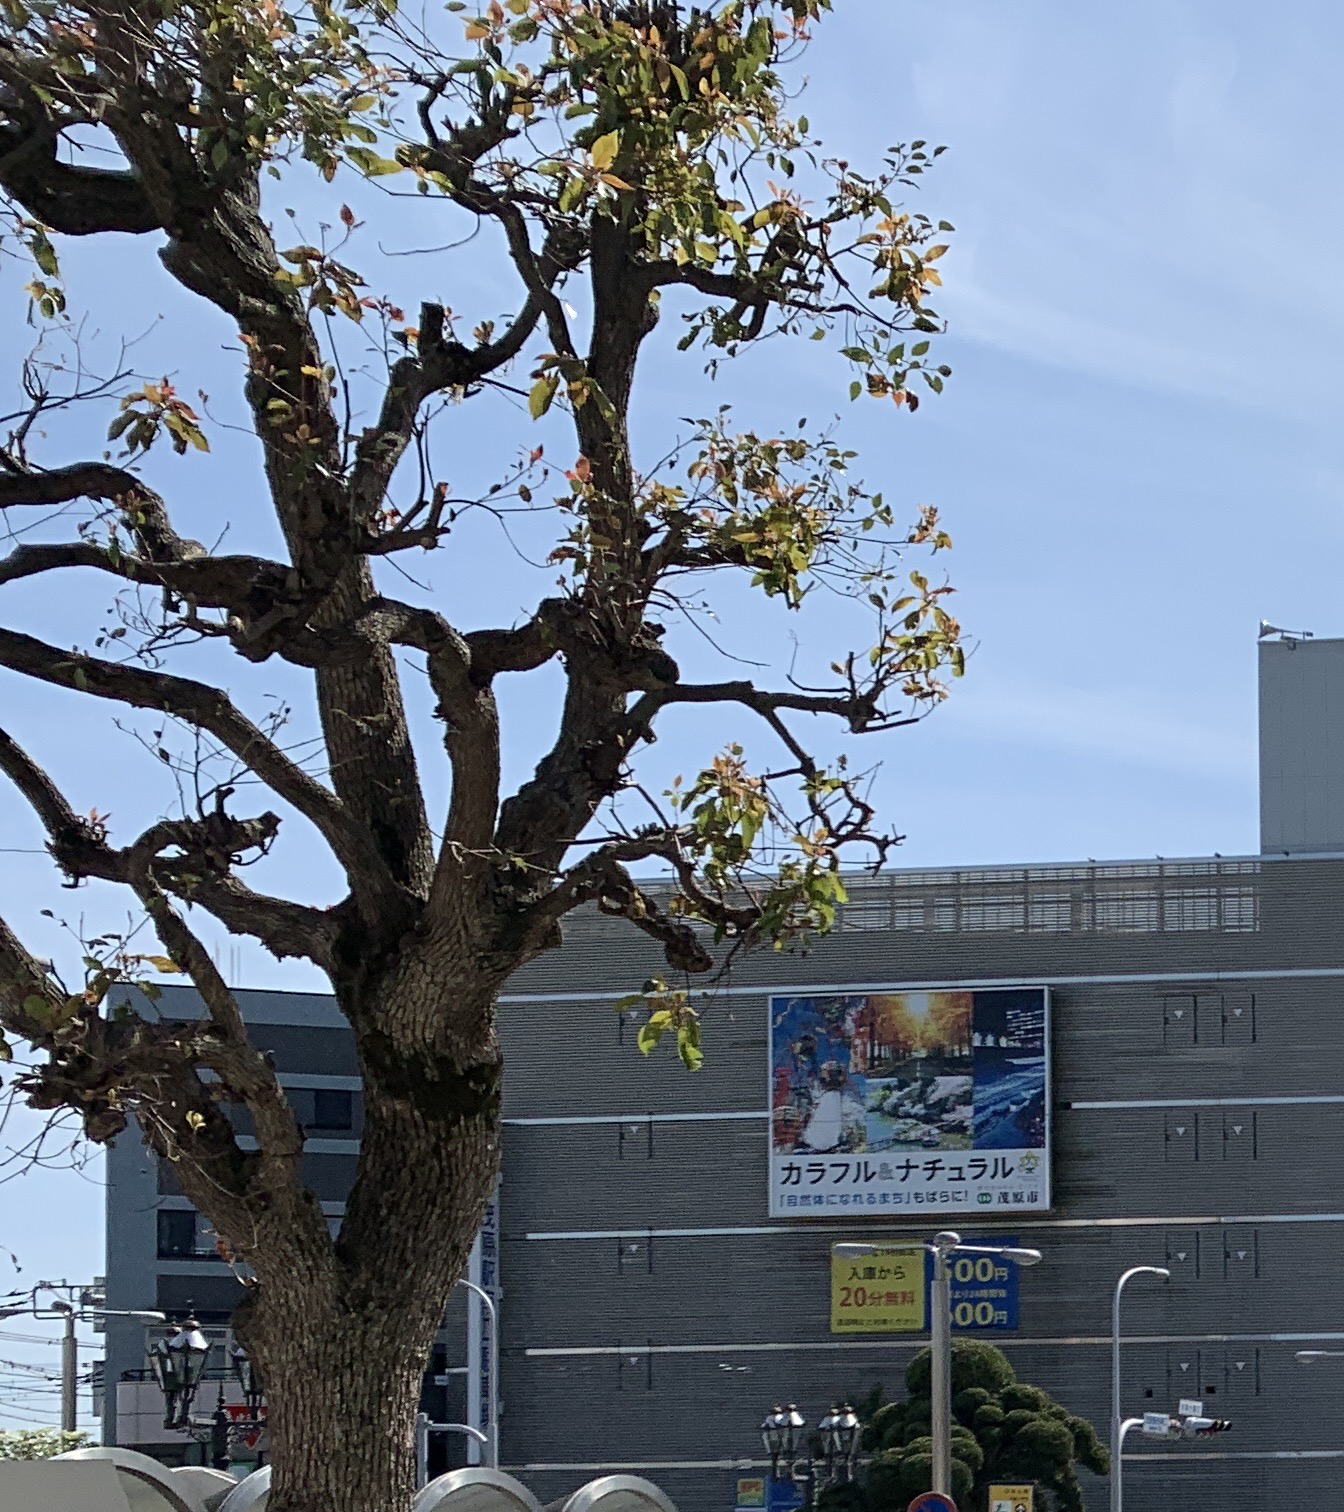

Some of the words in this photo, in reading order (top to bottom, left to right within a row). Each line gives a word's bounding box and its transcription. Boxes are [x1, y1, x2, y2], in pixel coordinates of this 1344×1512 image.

[780, 1156, 1014, 1185] カラフル&ナチュラル
[848, 1265, 906, 1281] 入庫から
[839, 1286, 916, 1307] 20分無料
[950, 1302, 1008, 1326] 00円
